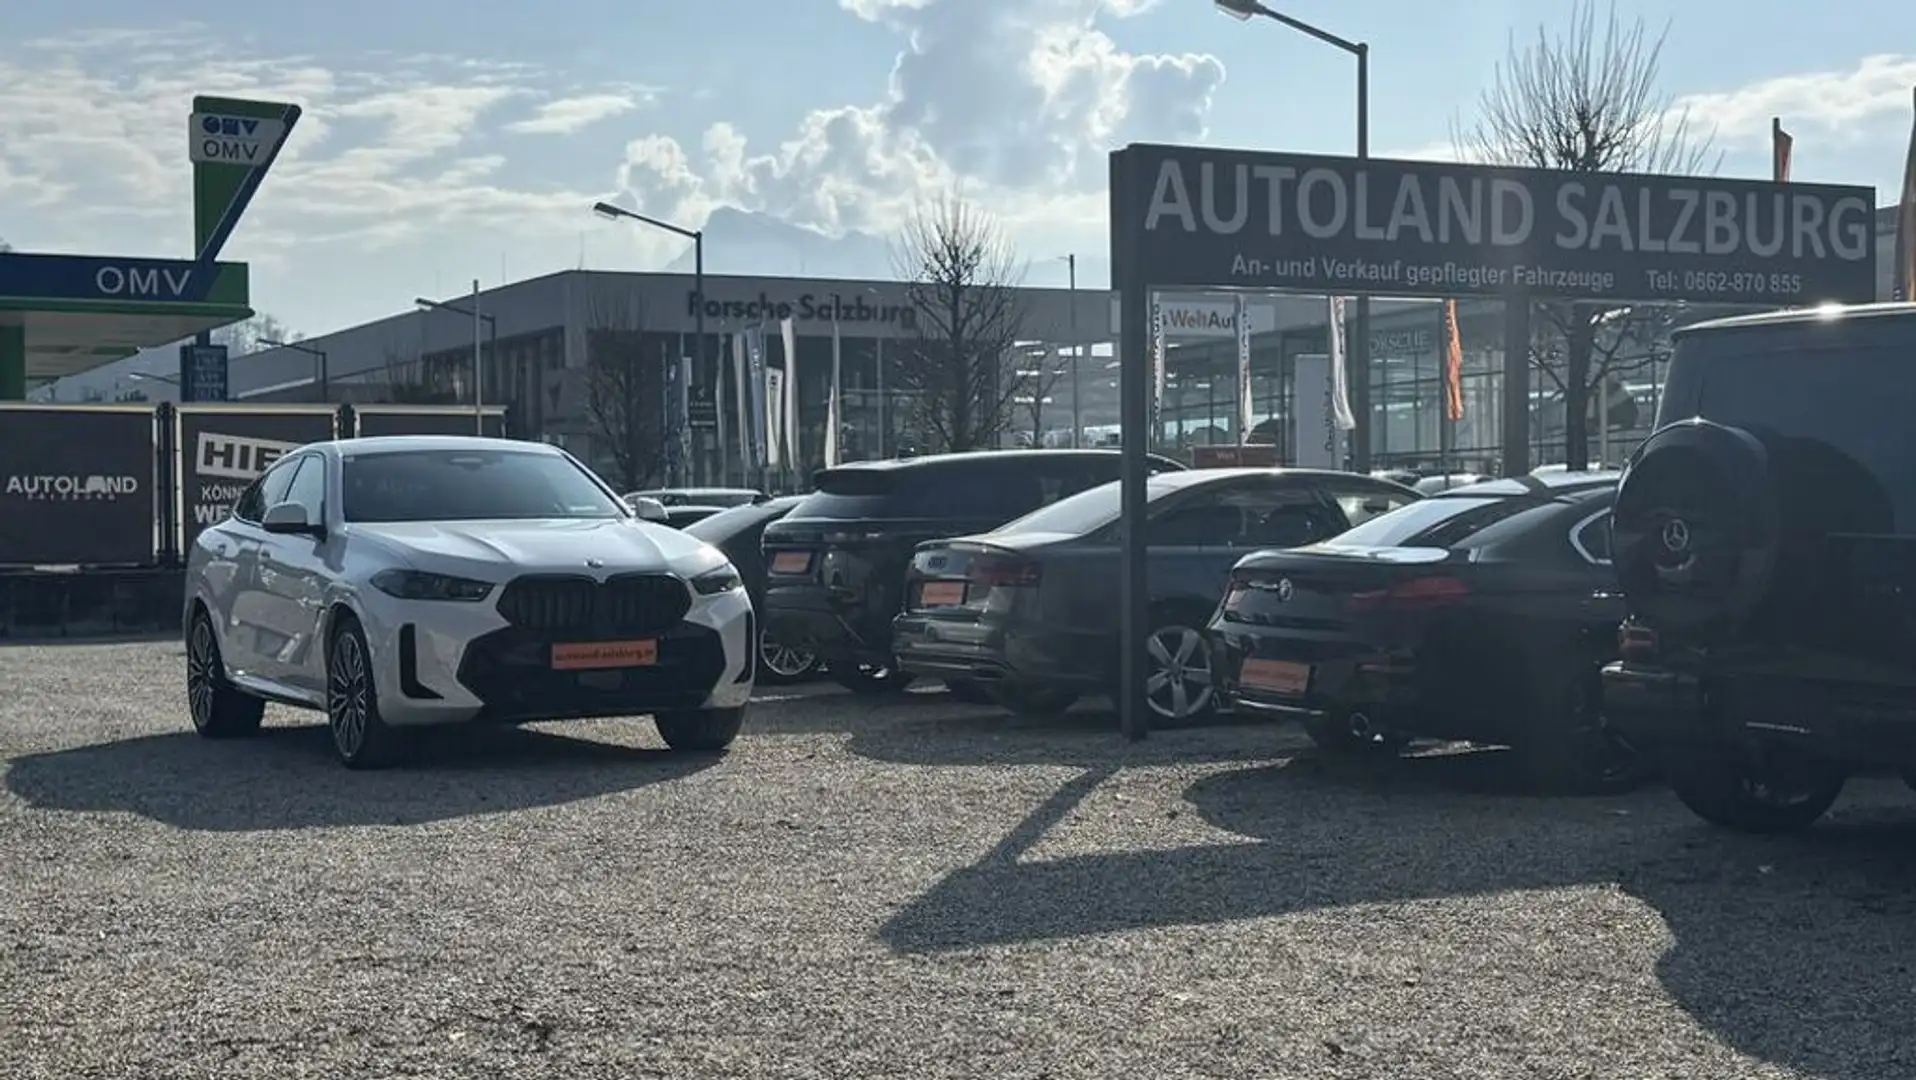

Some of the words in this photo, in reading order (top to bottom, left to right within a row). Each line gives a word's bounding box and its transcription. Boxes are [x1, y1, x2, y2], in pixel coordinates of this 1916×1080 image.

[203, 140, 260, 160] OMV
[1145, 159, 1535, 246] AUTOLAND
[1556, 181, 1868, 261] SALZBURG
[96, 265, 192, 297] OMV
[1231, 254, 1271, 277] An-
[1276, 258, 1316, 278] und
[1322, 258, 1401, 282] Verkauf
[1406, 262, 1506, 287] gepflegter
[1512, 265, 1614, 291] Fahrzeuge
[1646, 269, 1679, 290] Tel:
[1684, 271, 1766, 293] 0662-870
[686, 290, 792, 320] Porsche
[799, 293, 917, 330] Salzburg
[203, 441, 294, 472] HIE
[5, 475, 139, 494] AUTOLAND
